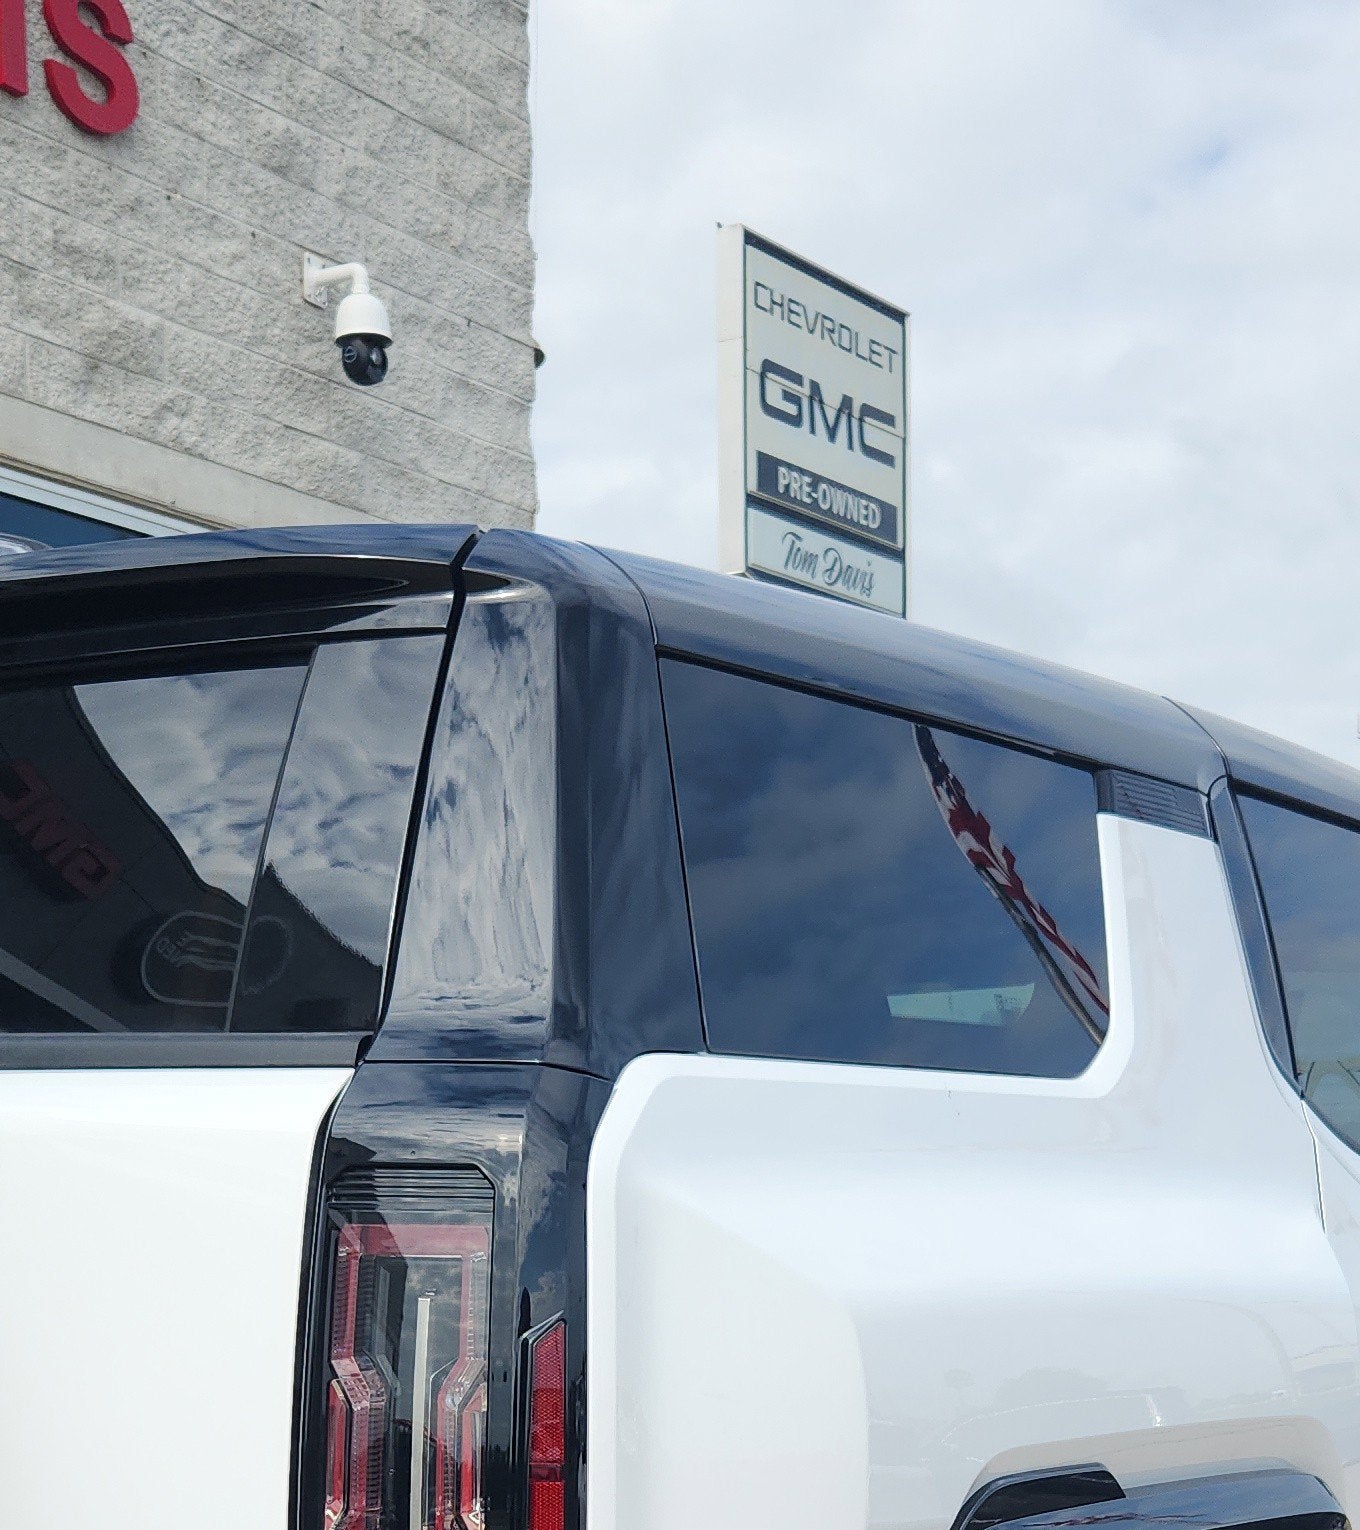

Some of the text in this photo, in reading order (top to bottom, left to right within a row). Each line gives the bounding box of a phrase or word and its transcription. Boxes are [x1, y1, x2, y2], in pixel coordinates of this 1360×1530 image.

[753, 281, 898, 373] CHEVROLET
[759, 358, 896, 469] GMC
[777, 465, 882, 529] PRE-OWNED
[782, 531, 876, 598] Tom Davis
